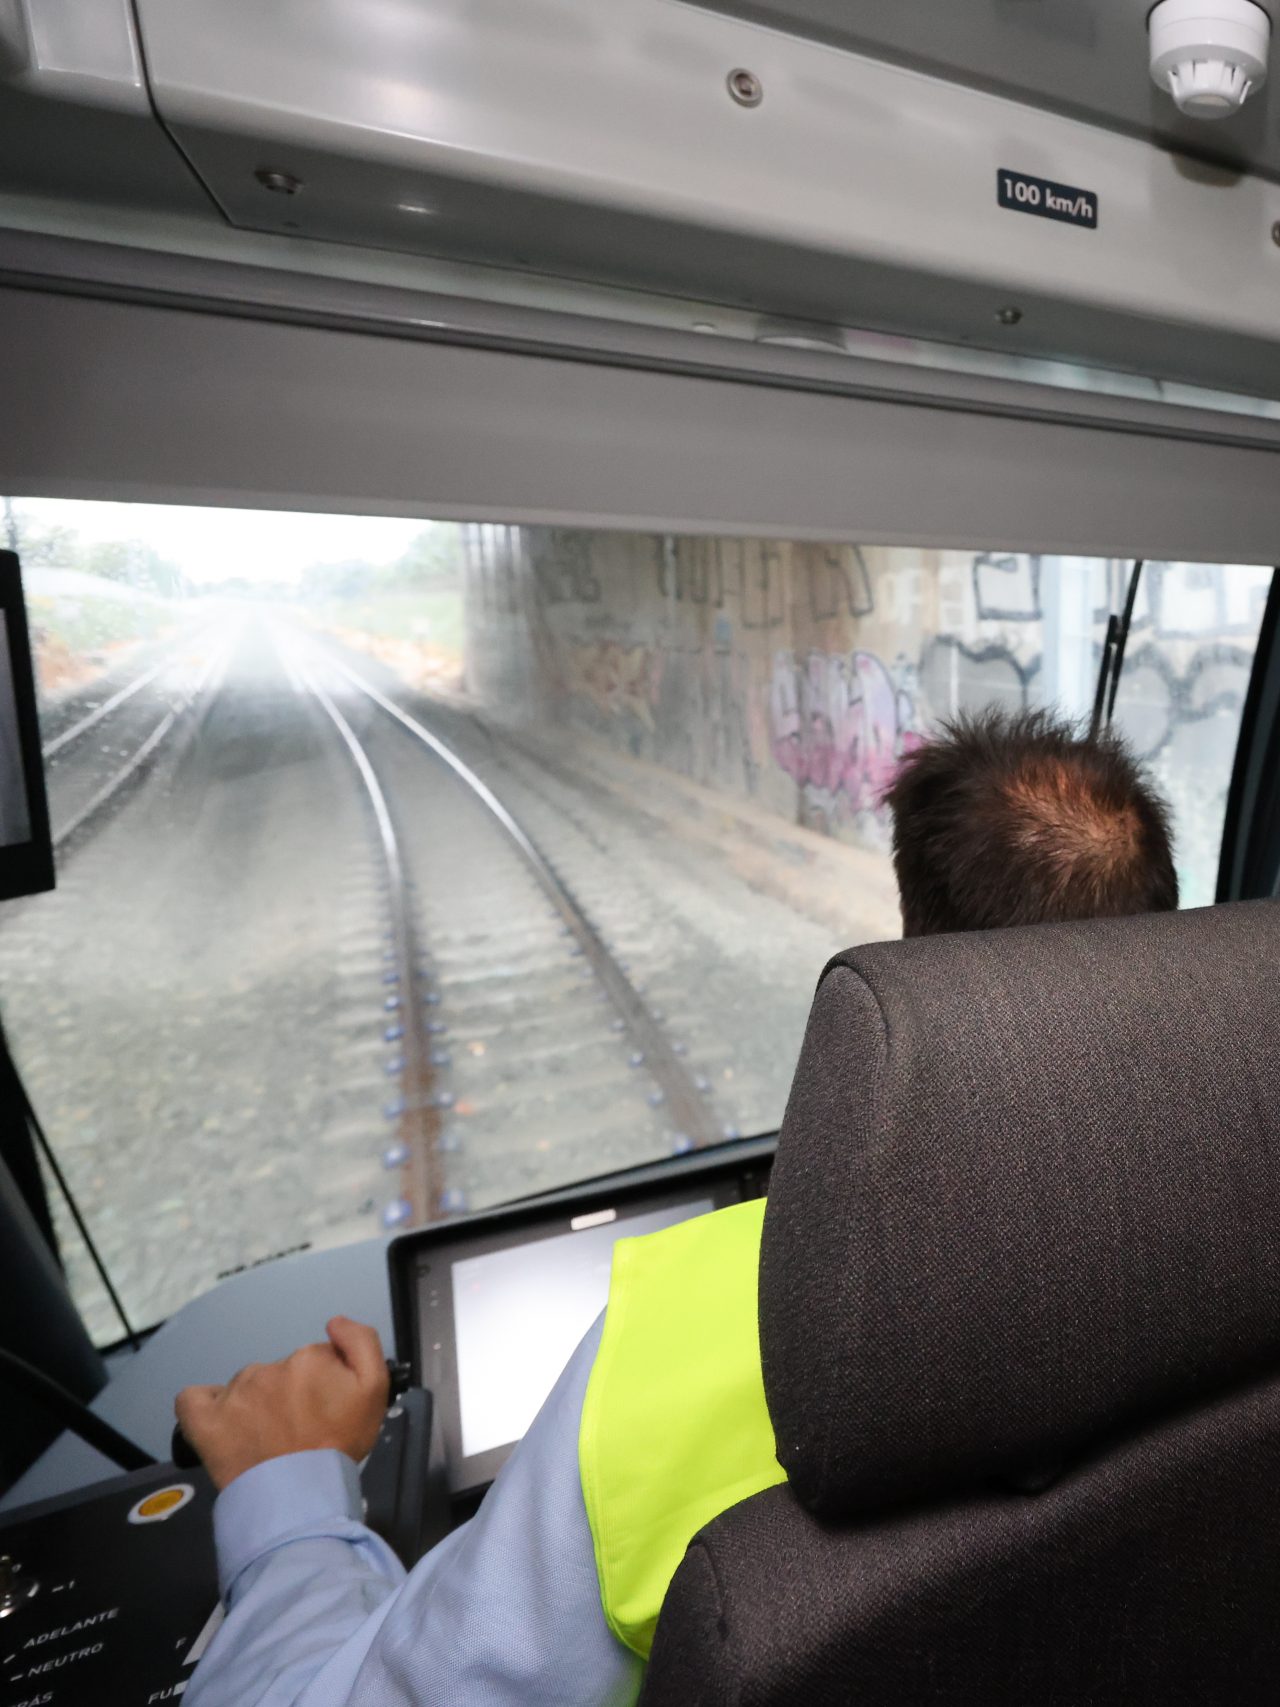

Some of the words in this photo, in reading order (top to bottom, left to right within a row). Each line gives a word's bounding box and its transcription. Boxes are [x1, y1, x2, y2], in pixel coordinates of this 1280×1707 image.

[1004, 179, 1041, 205] 100
[1045, 188, 1093, 218] km/h
[23, 1607, 119, 1650] ADELANTE
[27, 1641, 104, 1678] NEUTRO
